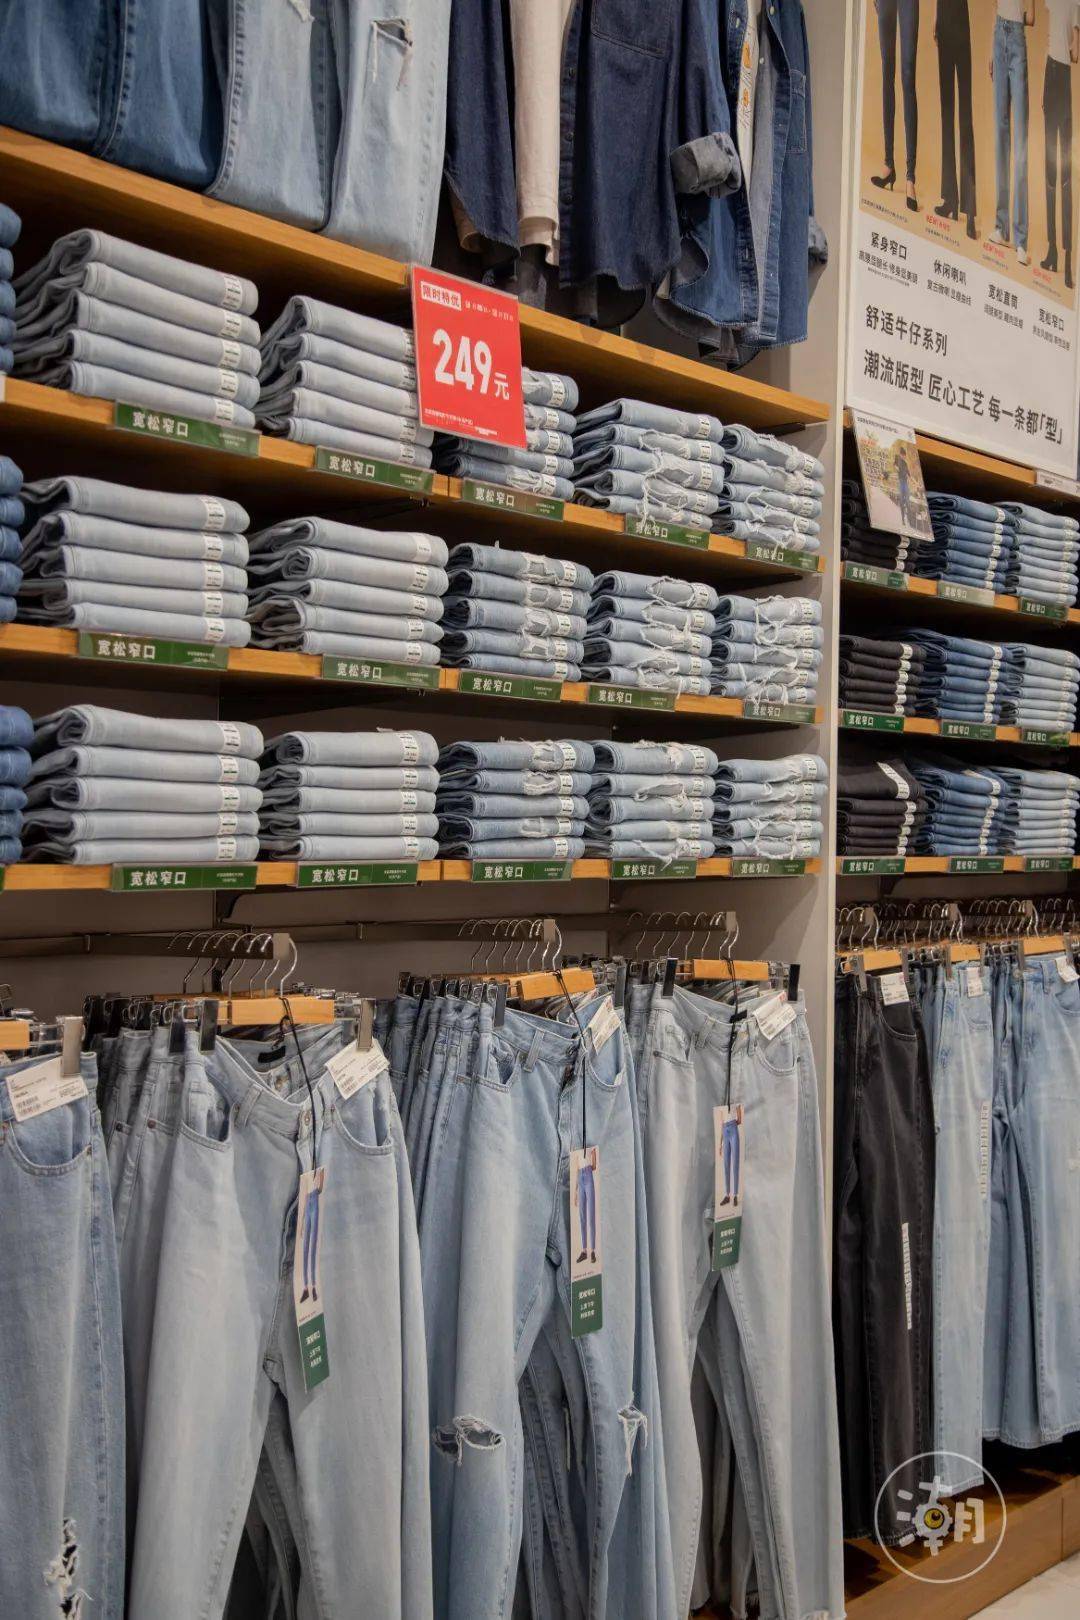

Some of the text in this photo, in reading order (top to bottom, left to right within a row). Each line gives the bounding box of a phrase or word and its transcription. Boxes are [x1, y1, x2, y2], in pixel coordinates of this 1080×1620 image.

[871, 232, 907, 260] 紧身窄口
[934, 259, 967, 286] 休闲喇叭
[988, 284, 1018, 310] 宽松直筒
[865, 304, 948, 357] 舒适牛仔系列
[863, 349, 1063, 444] 潮流版型 匠心工艺 每一条都「型」
[132, 411, 189, 438] 宽松窄口
[329, 455, 376, 478] 宽松窄口
[475, 487, 515, 507] 宽松窄口
[98, 639, 156, 660] 宽松窄口
[337, 662, 382, 680] 宽松窄口
[472, 677, 513, 693] 宽松窄口
[598, 690, 632, 704] 宽松窄口
[130, 870, 187, 886] 宽松窄口
[312, 868, 360, 884] 宽松窄口
[484, 866, 523, 879] 宽松窄口
[622, 864, 656, 877] 宽松窄口
